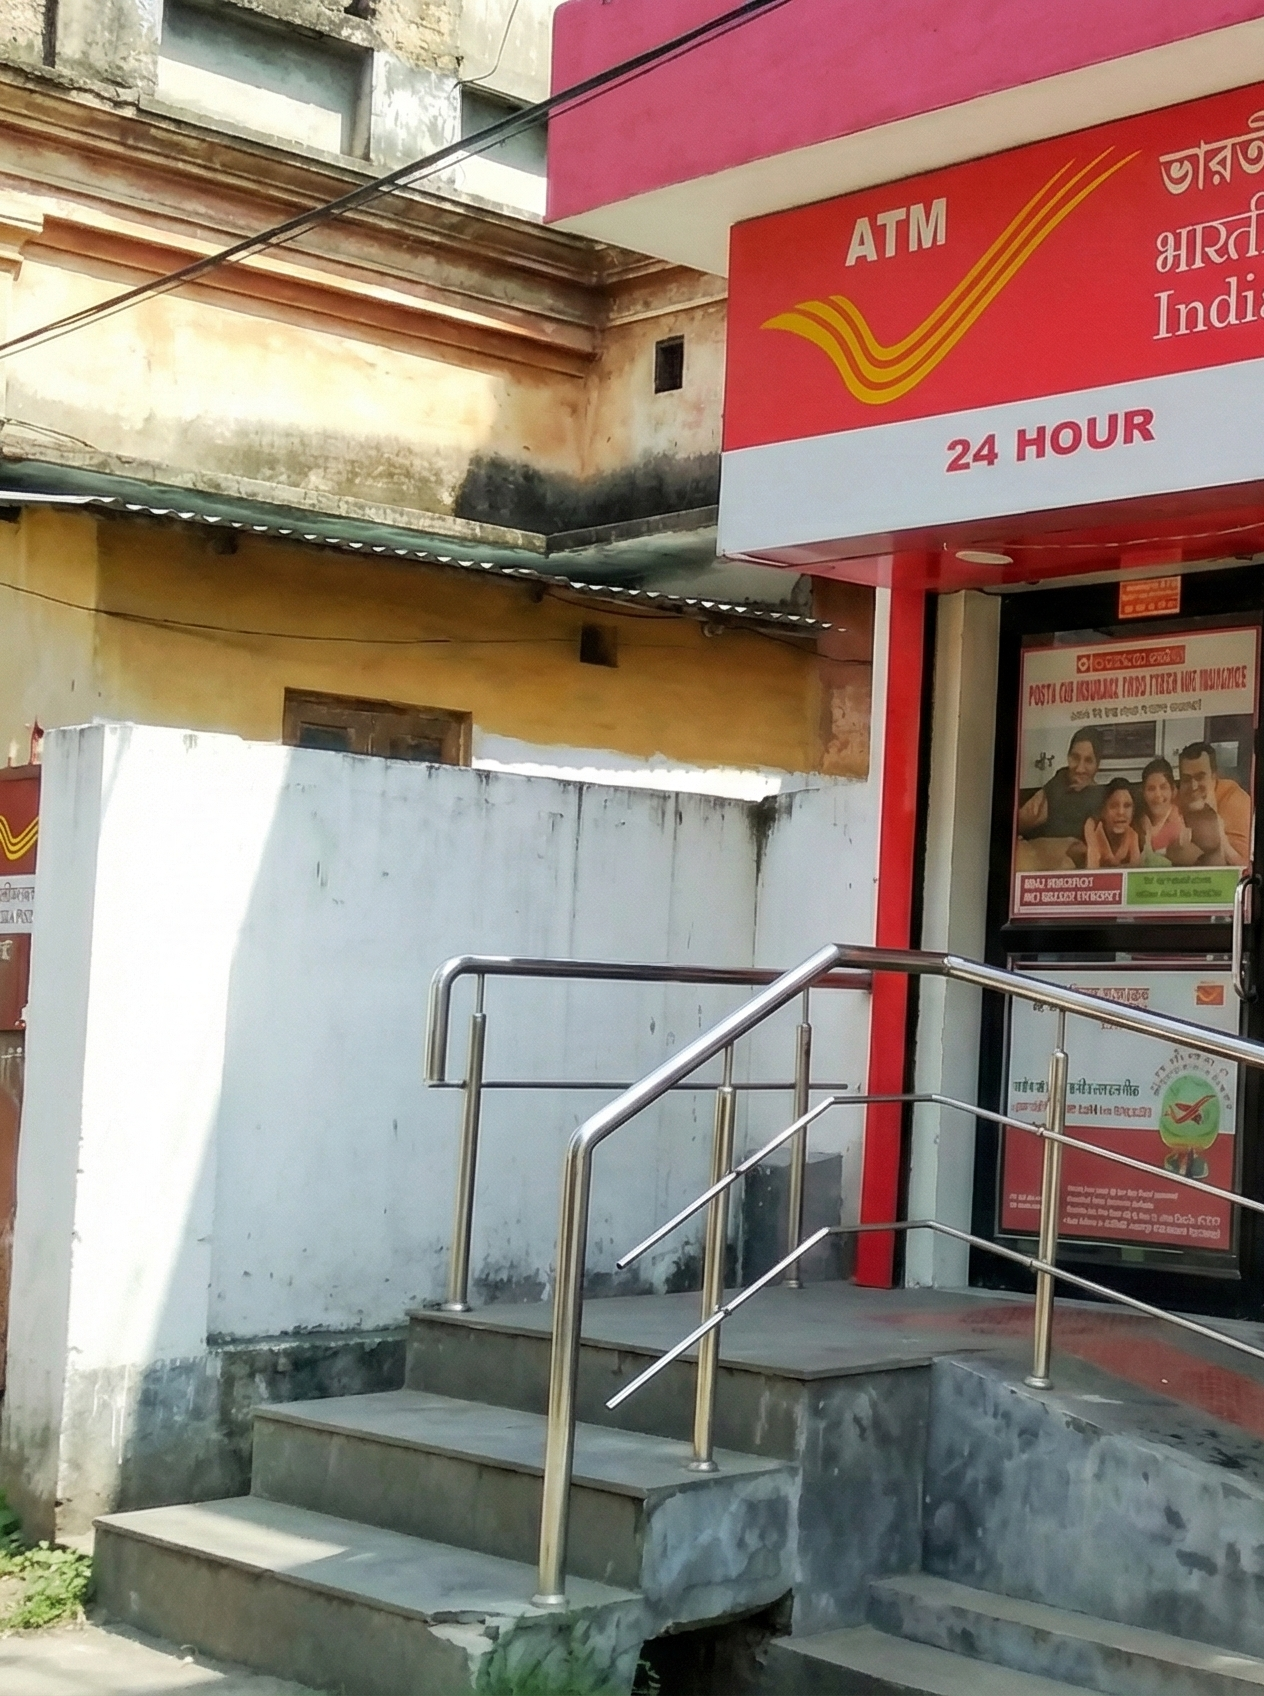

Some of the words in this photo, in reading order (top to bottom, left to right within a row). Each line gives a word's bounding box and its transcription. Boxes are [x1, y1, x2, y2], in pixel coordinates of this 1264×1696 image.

[845, 198, 948, 267] ATM
[946, 433, 999, 474] 24
[1016, 407, 1156, 462] HOUR
